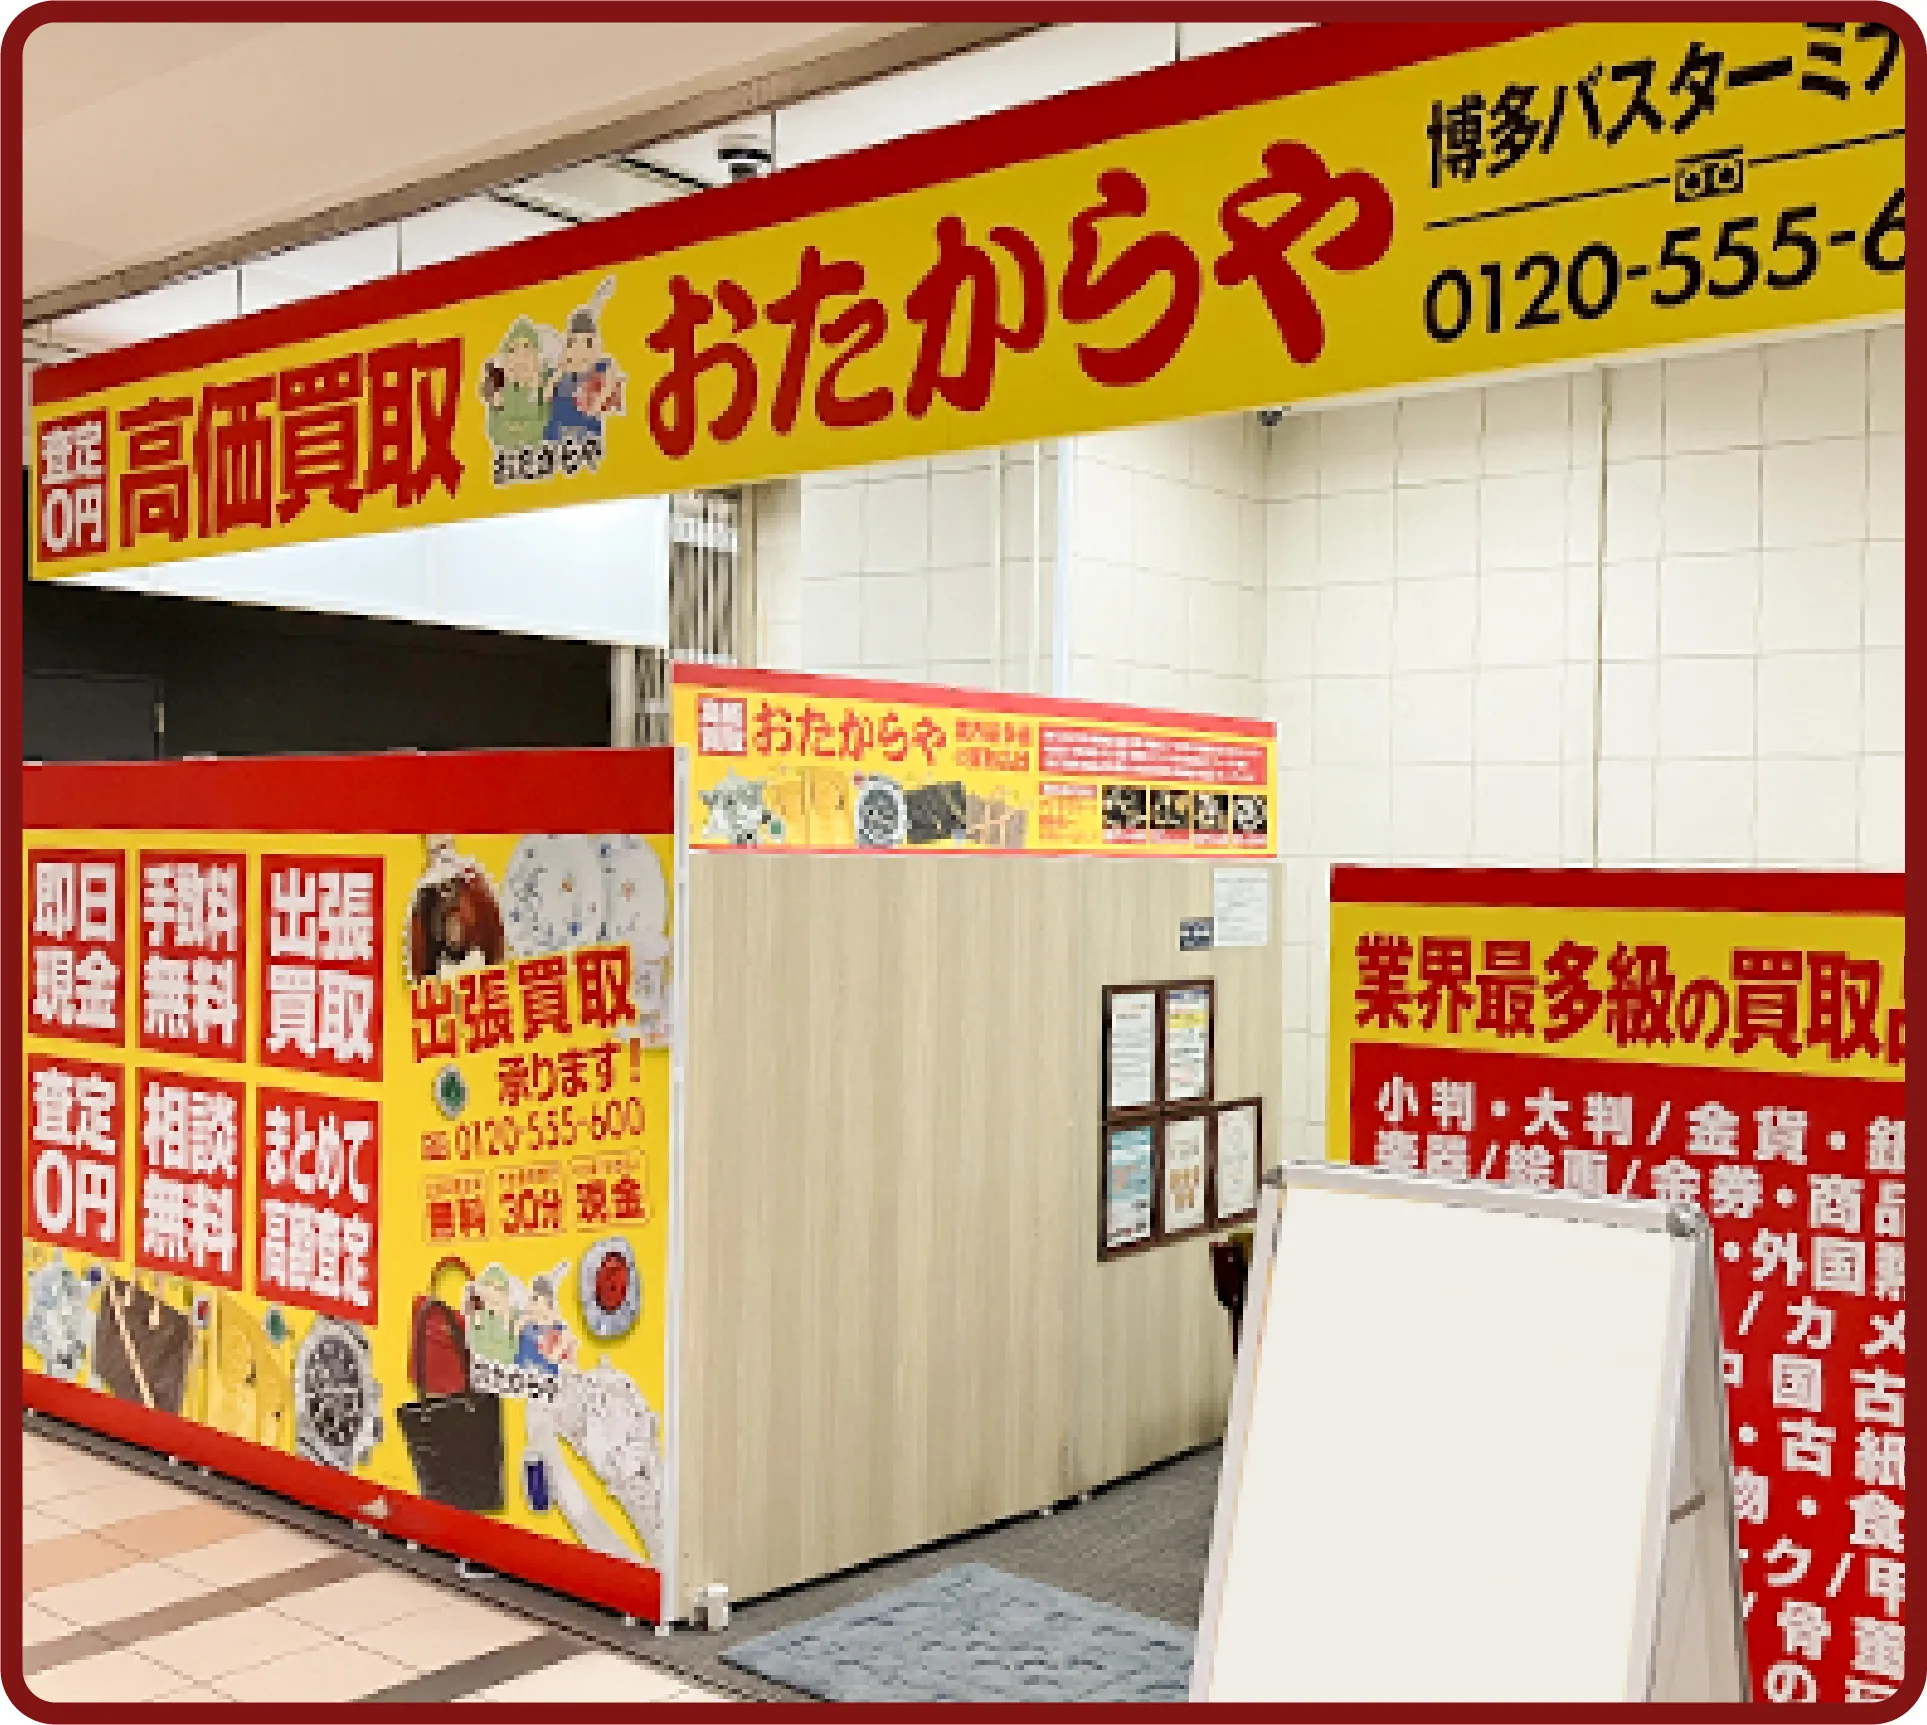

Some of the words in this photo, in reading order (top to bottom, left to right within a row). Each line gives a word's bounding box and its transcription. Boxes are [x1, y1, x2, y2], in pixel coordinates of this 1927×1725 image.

[645, 140, 1395, 460] おたからや
[42, 420, 103, 485] 査定
[118, 336, 465, 548] 高価買取
[42, 478, 103, 550] 0円
[752, 699, 946, 766] おたからや
[33, 862, 116, 941] 即日
[271, 868, 373, 963] 出張
[33, 946, 120, 1028] 現金
[144, 955, 237, 1047] 無料
[266, 964, 373, 1063] 買取
[411, 946, 637, 1063] 出張買取
[33, 1067, 115, 1155] 査定
[144, 1082, 237, 1180] 相談
[266, 1106, 373, 1203] まとめて
[33, 1150, 116, 1243] 0円
[144, 1173, 237, 1272] 無料
